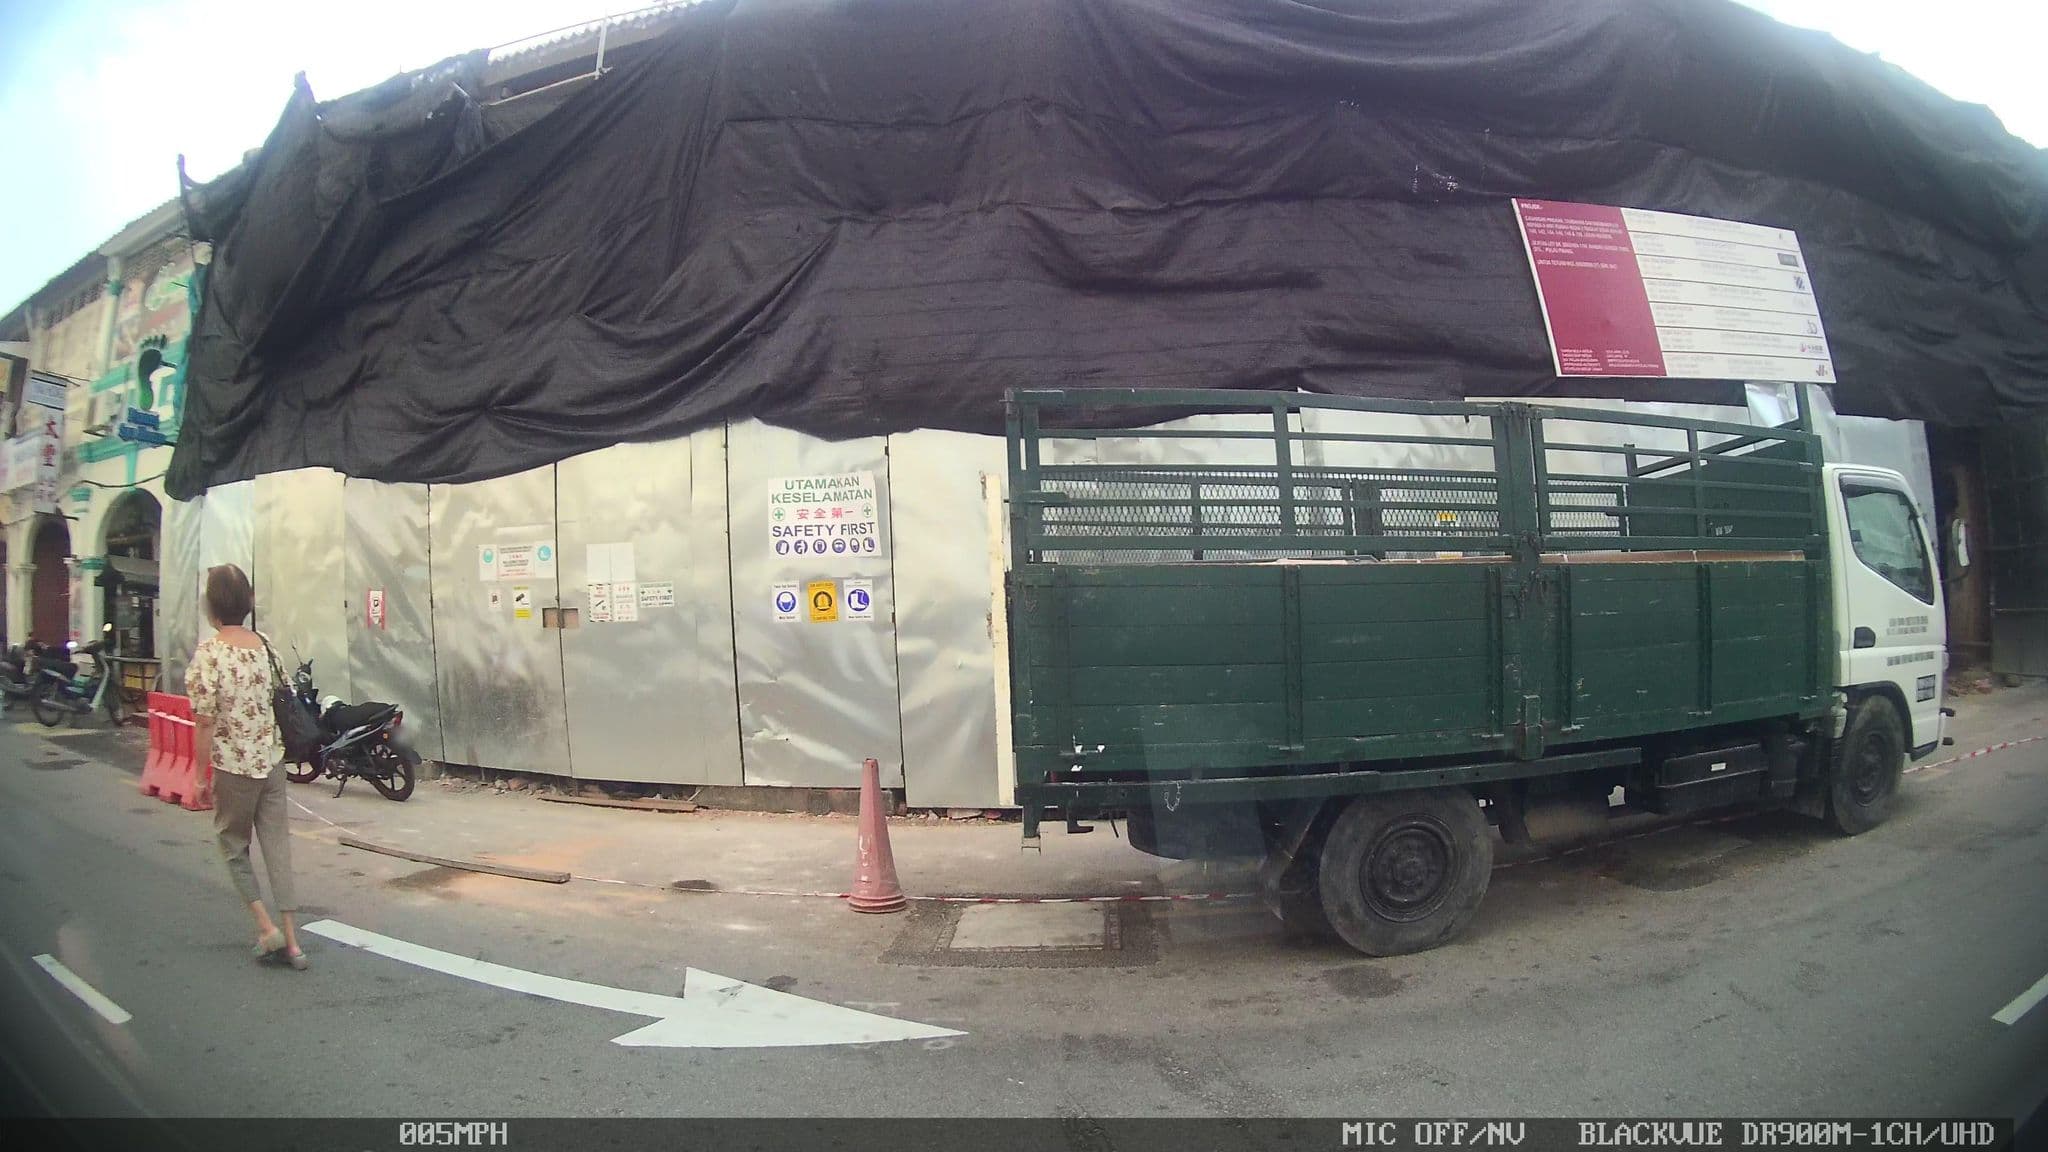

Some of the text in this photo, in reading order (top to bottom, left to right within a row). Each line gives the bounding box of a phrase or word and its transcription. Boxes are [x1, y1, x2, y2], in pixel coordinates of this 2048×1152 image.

[785, 476, 860, 490] UTAMAKAN
[771, 489, 873, 504] KESELAMATAN
[797, 507, 854, 520] 安全第一
[772, 522, 875, 538] SAFETY FIRST
